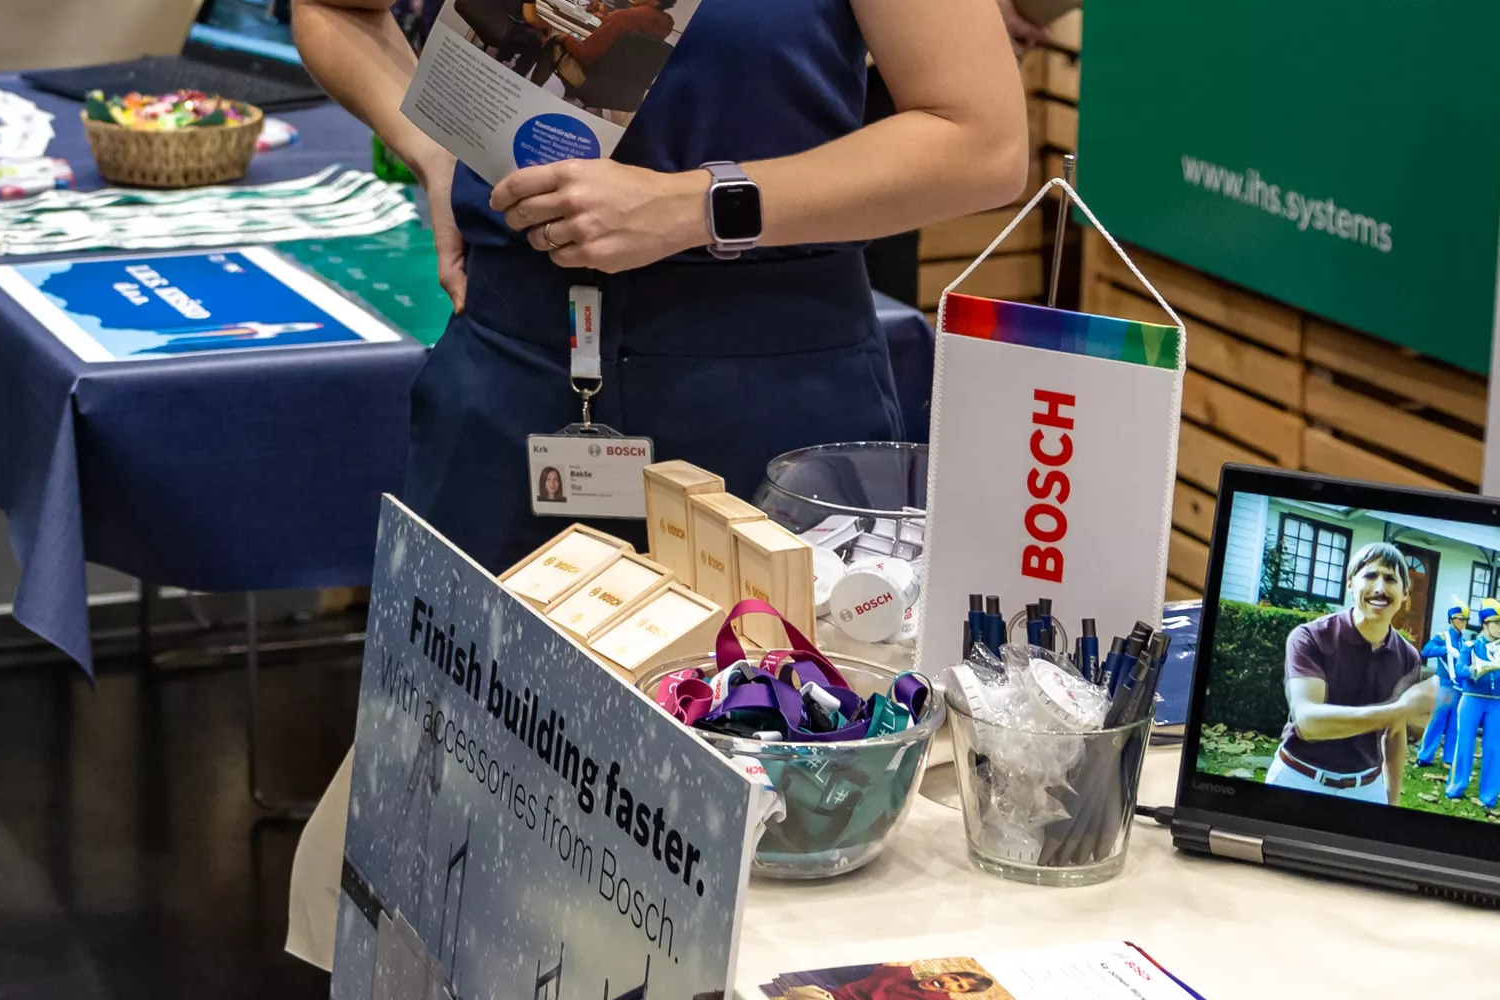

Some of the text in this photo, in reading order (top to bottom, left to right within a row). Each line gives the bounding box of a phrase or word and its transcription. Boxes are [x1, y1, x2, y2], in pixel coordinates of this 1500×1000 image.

[1181, 154, 1392, 252] www.ihs.systems
[584, 305, 592, 332] BOSCH
[533, 445, 646, 457] Krk BOSCH
[1021, 388, 1076, 584] BOSCH
[667, 523, 686, 541] BOSCH
[554, 560, 581, 575] BOSCH
[598, 591, 624, 608] BOSCH
[854, 591, 894, 616] BOSCH
[409, 595, 706, 899] Finish building faster.
[1191, 779, 1236, 796] Lenovo
[380, 650, 681, 964] With accessories from Bosch.
